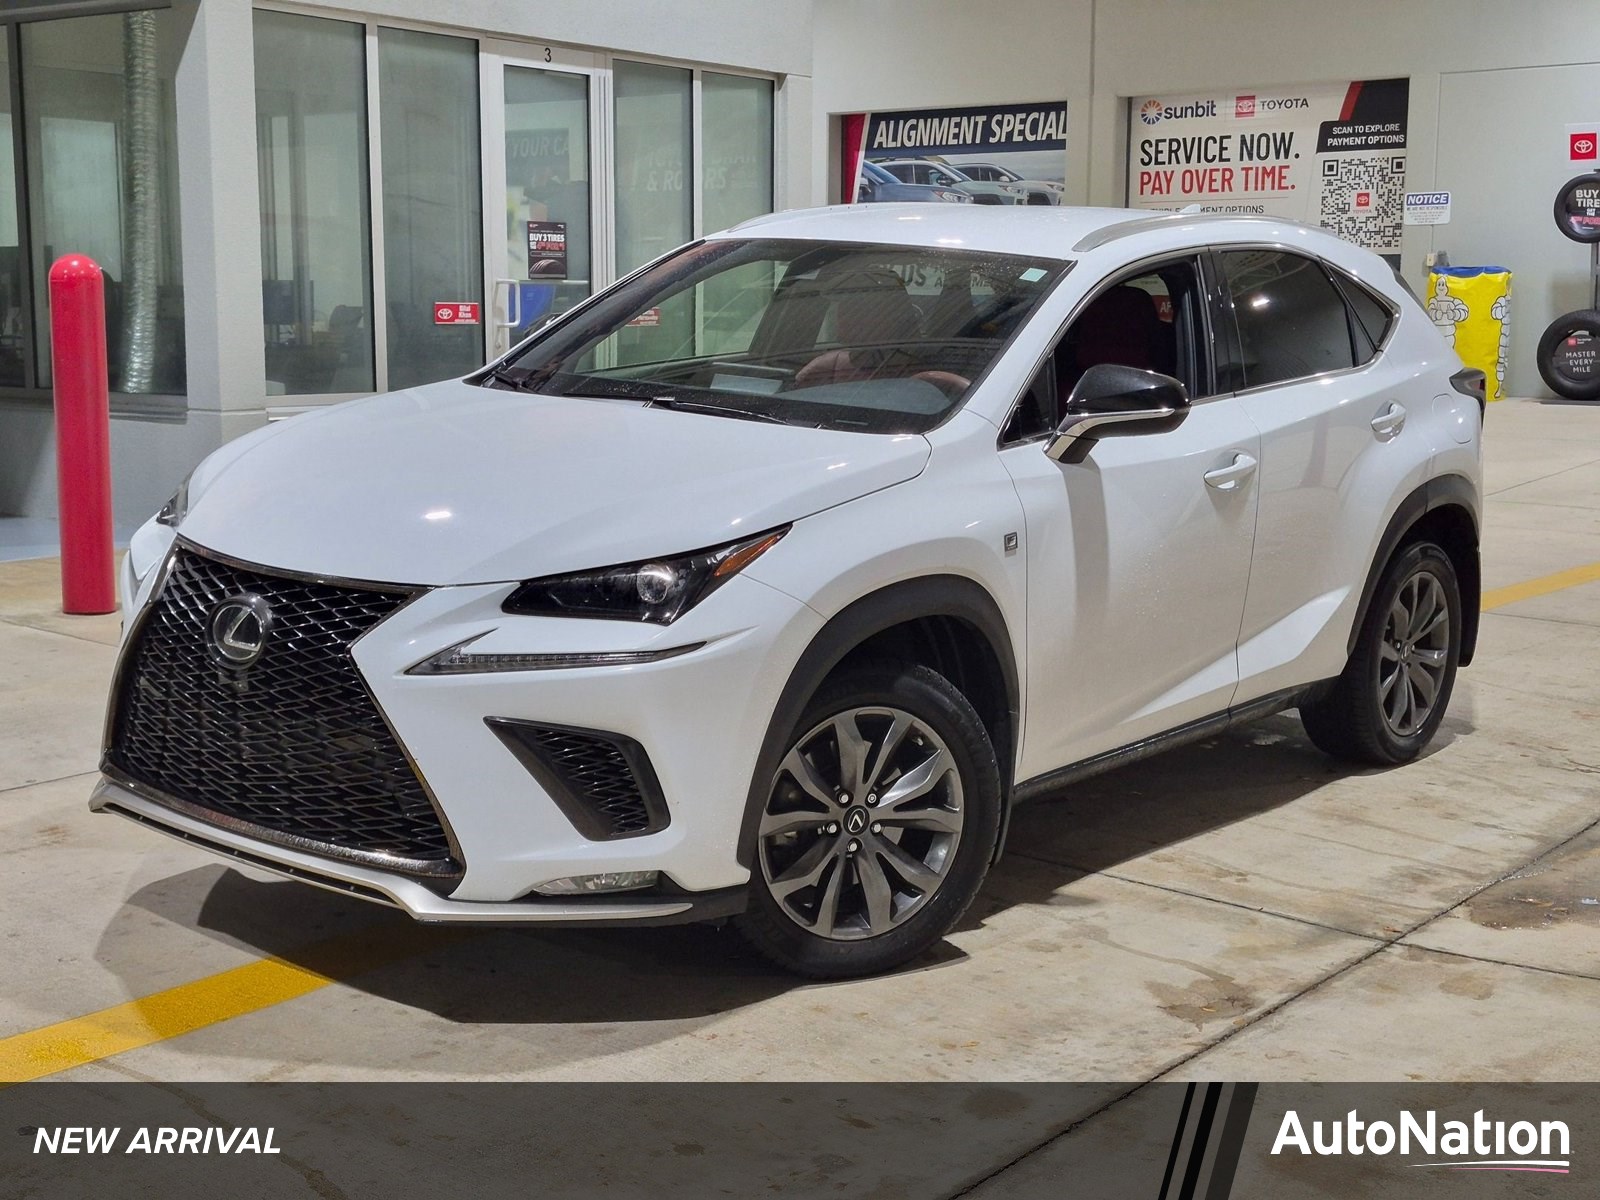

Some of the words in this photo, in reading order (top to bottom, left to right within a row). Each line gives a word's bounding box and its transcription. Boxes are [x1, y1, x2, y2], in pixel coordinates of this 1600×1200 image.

[544, 47, 552, 63] 3
[1163, 100, 1217, 120] sunbit
[1260, 98, 1309, 110] TOYOTA
[873, 115, 987, 149] ALIGNMENT
[989, 111, 1067, 144] SPECIAL
[1332, 126, 1353, 135] SCAN
[1354, 125, 1364, 134] TO
[1365, 123, 1400, 133] EXPLORE
[1327, 136, 1367, 146] PAYMENT
[1367, 134, 1405, 145] OPTIONS
[1140, 134, 1232, 167] SERVICE
[1239, 131, 1300, 162] NOW.
[1139, 170, 1175, 196] PAY
[1181, 167, 1234, 194] OVER
[1240, 165, 1296, 192] TIME.
[1408, 194, 1447, 204] NOTICE
[1575, 189, 1599, 198] BUY
